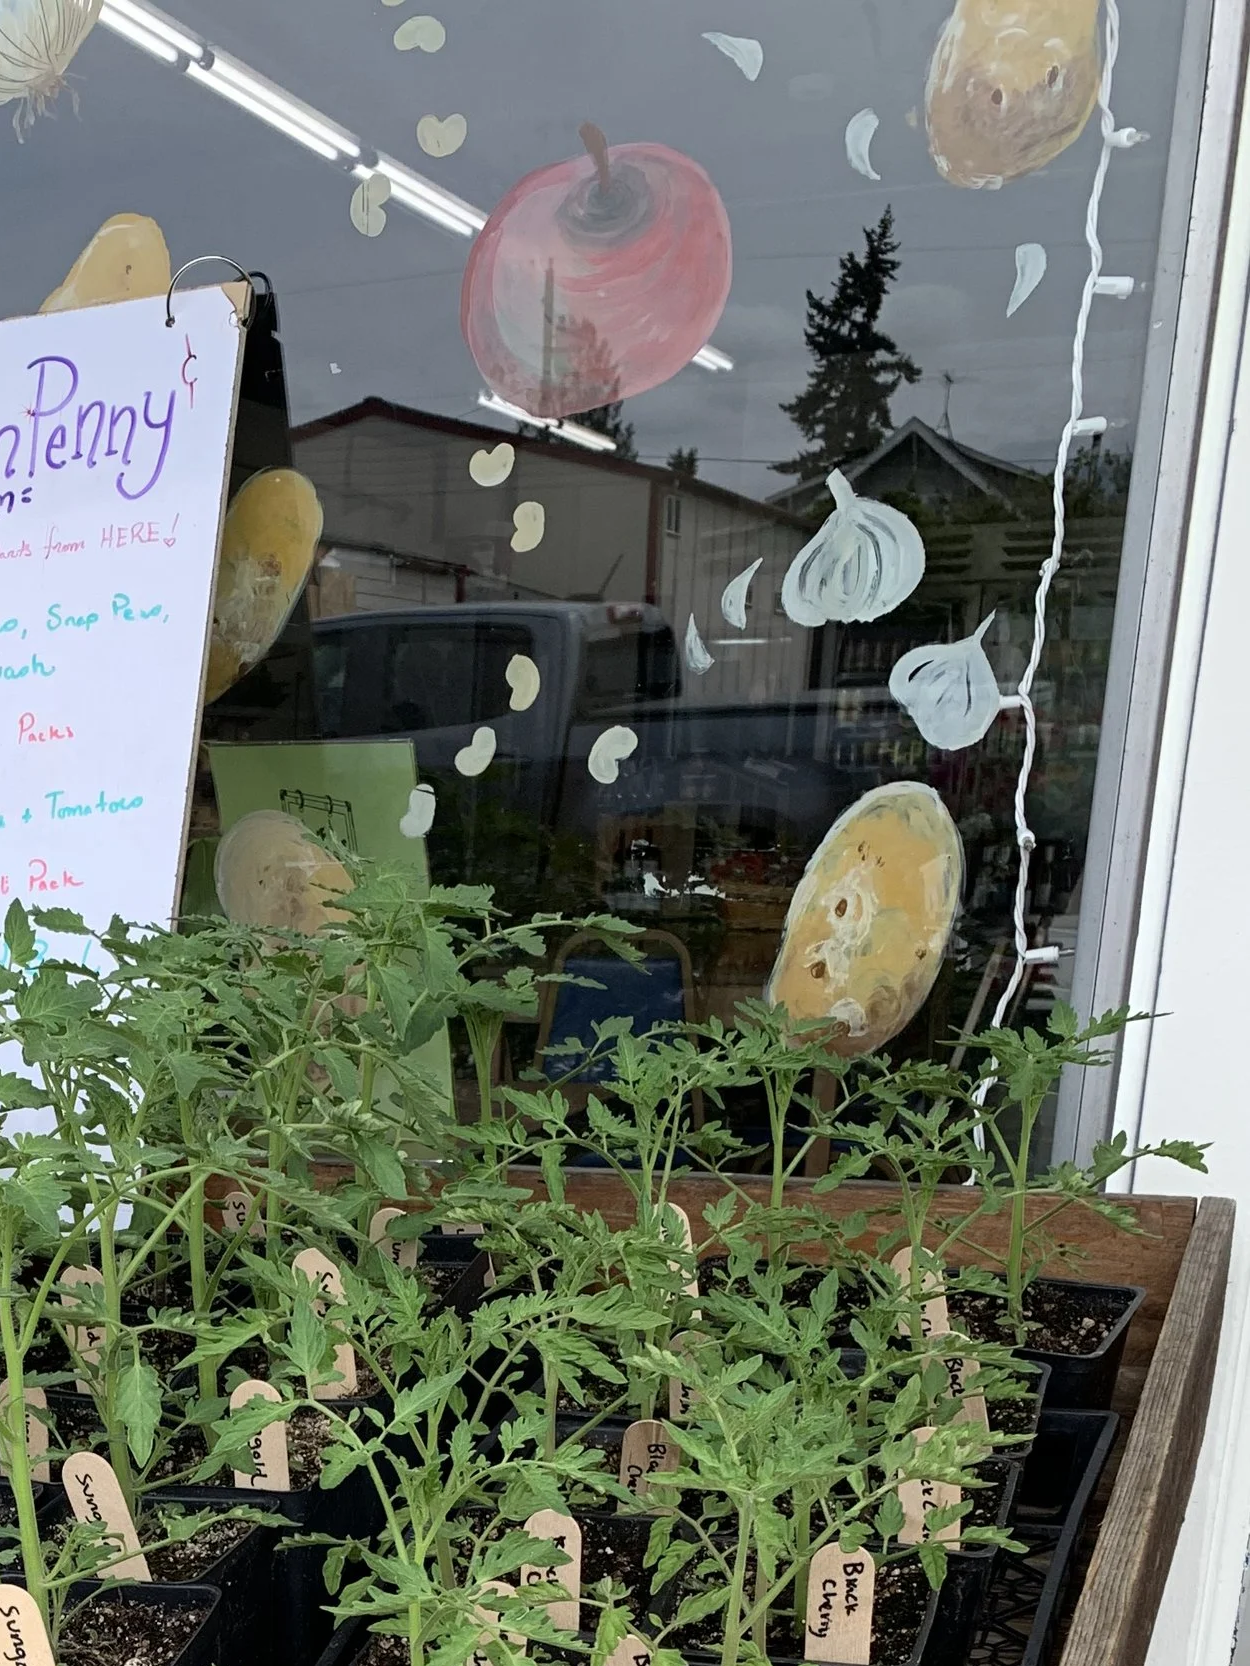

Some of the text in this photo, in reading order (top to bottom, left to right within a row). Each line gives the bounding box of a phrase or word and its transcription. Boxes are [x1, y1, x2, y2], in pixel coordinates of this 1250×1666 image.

[26, 355, 176, 500] Penny
[44, 524, 85, 560] from
[46, 603, 99, 632] Snap
[17, 712, 75, 745] Packs
[27, 858, 85, 893] Pack
[807, 1579, 837, 1639] Cherry
